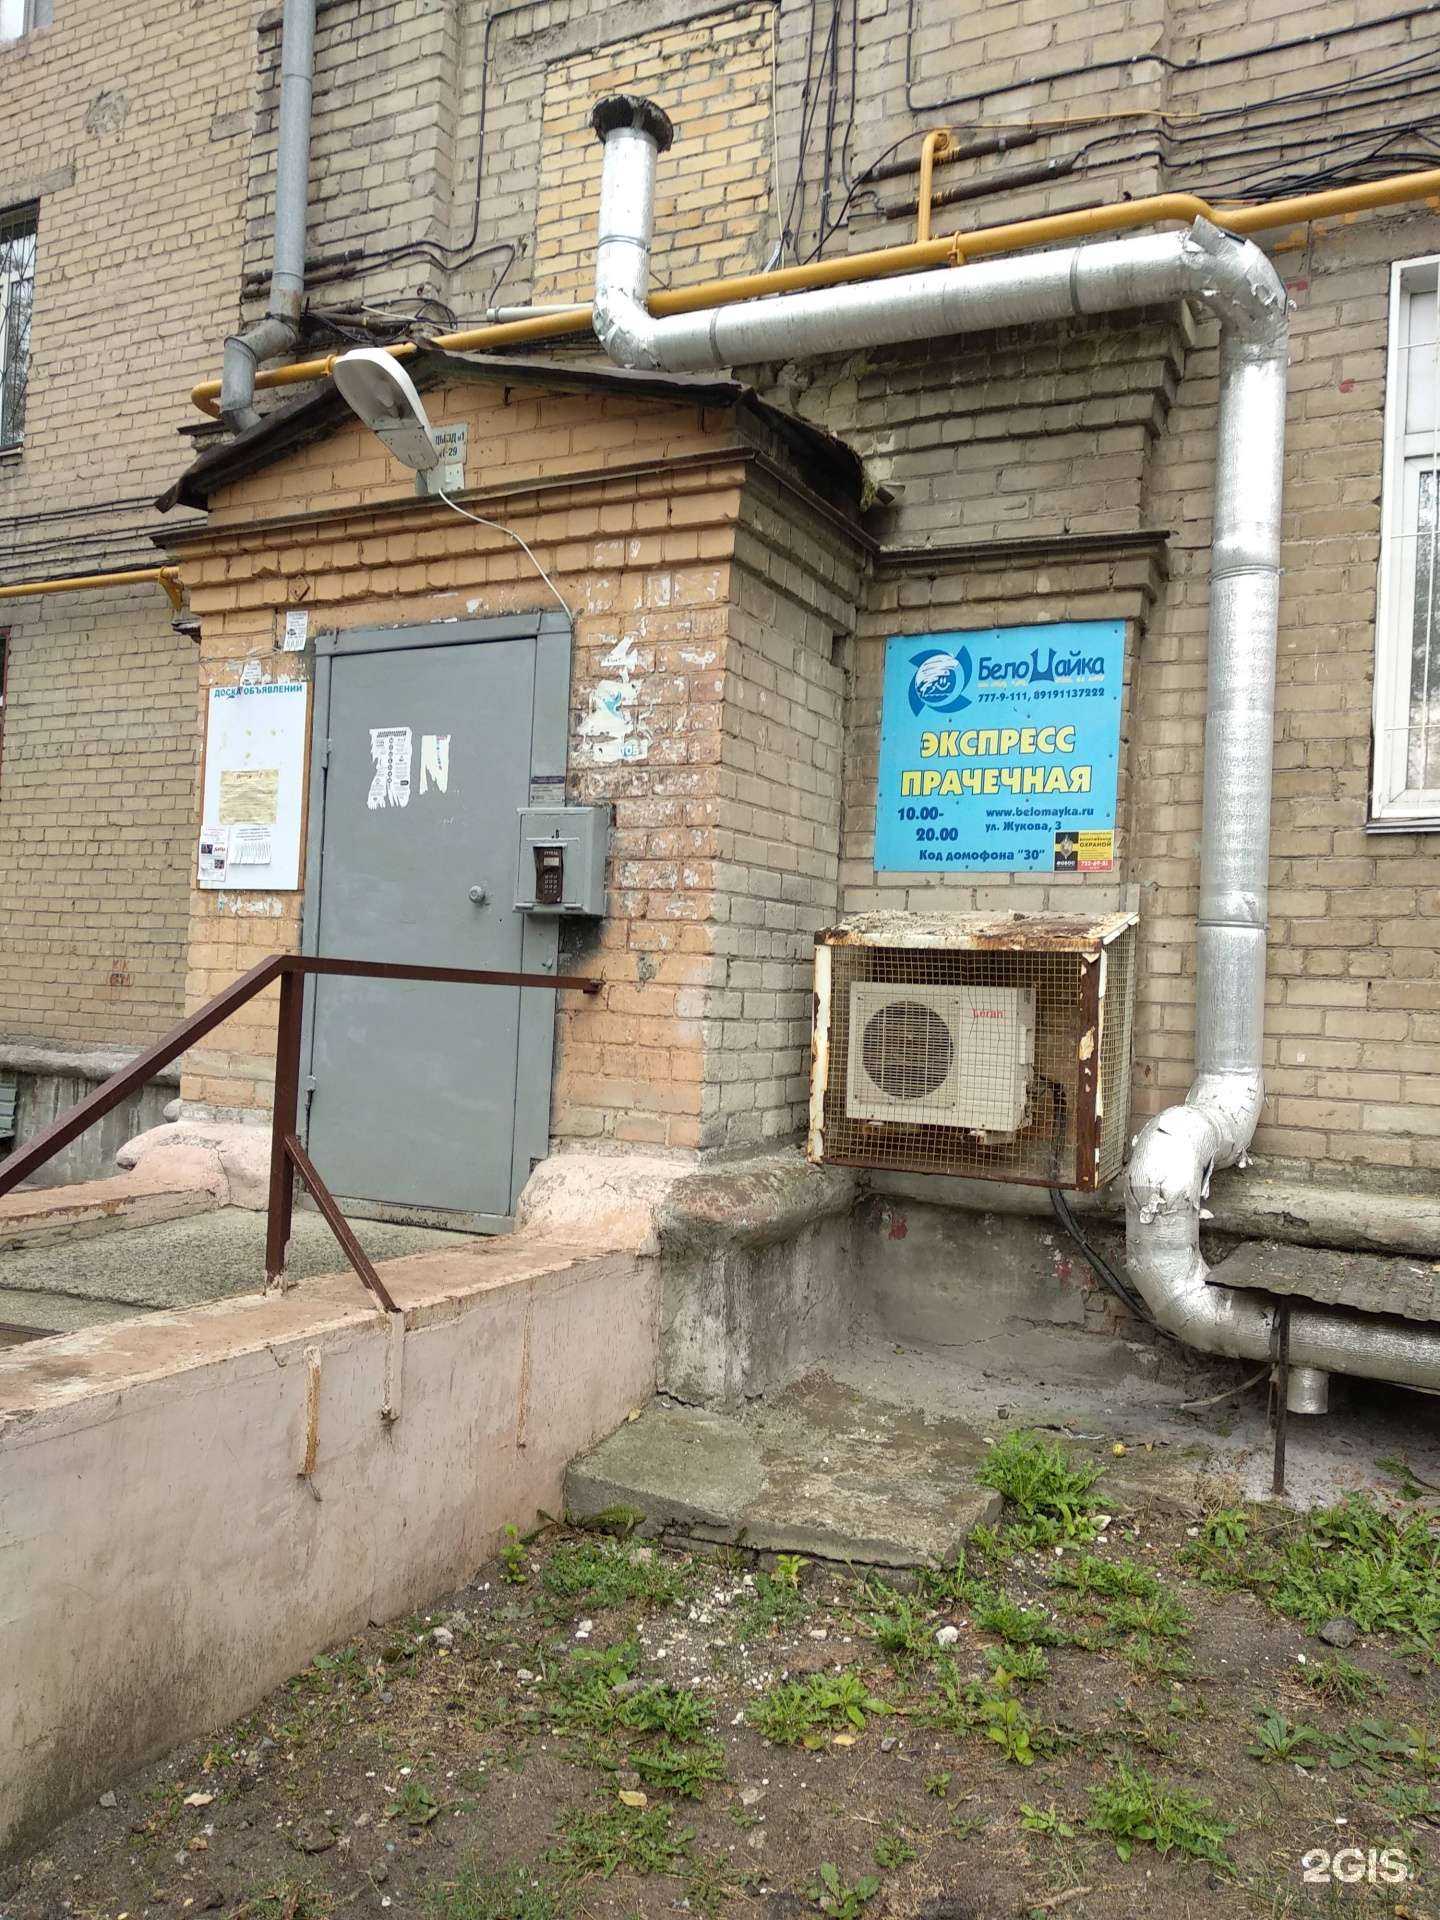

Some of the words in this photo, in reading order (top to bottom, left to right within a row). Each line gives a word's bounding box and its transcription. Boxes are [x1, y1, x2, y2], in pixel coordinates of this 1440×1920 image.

[214, 688, 242, 698] ДОСКА
[978, 691, 1031, 703] 777-9-111,
[1033, 688, 1105, 700] 89191137222
[920, 725, 1076, 758] ЭКСПРЕСС
[901, 765, 1092, 797] ПРАЧЕЧНАЯ
[898, 806, 945, 821] 10.00-
[986, 806, 1094, 818] www.belomayka.ru
[985, 822, 1000, 832] ул.
[1002, 821, 1052, 832] Жукова,
[1055, 820, 1061, 830] 3
[916, 827, 958, 842] 20.00
[919, 849, 943, 861] Код
[946, 850, 1015, 862] домофона
